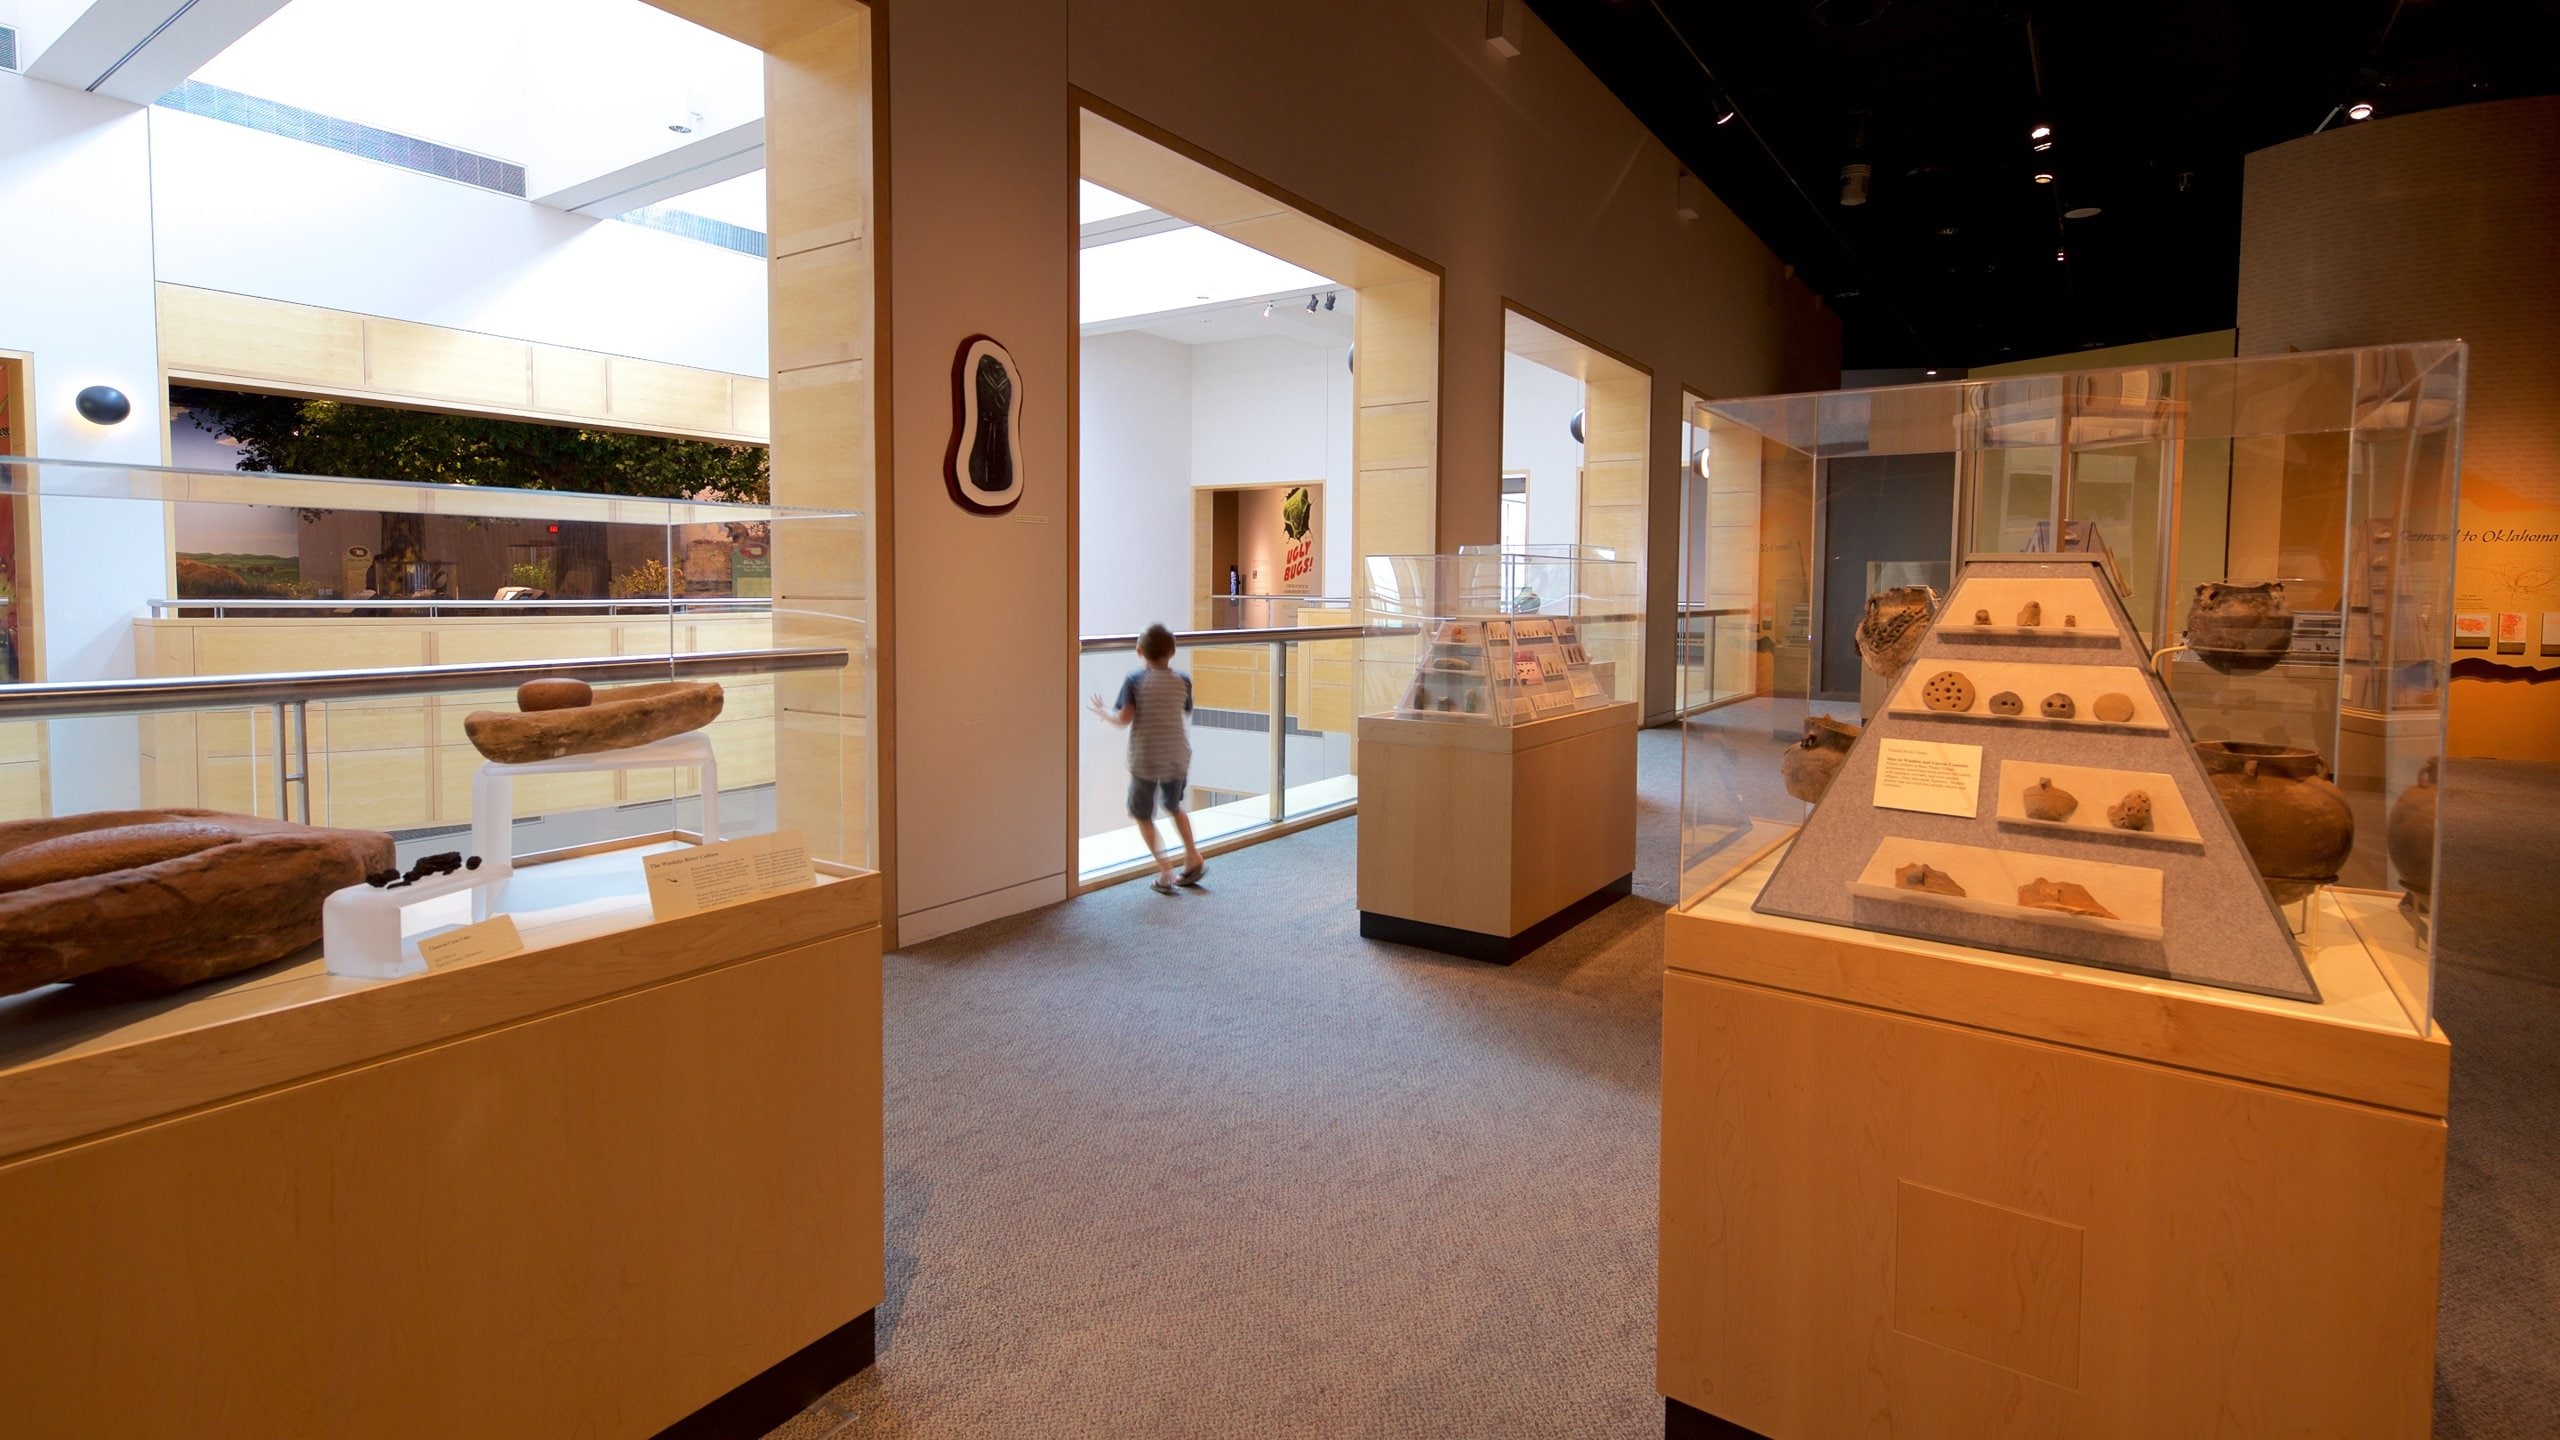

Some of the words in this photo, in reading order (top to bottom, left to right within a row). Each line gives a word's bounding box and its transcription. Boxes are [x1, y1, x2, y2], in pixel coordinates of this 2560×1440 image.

[2401, 529, 2462, 542] Removl
[2462, 530, 2478, 542] to
[2482, 529, 2560, 543] Oklahoma
[1286, 540, 1312, 565] UGLY
[1284, 556, 1314, 582] BUGS!
